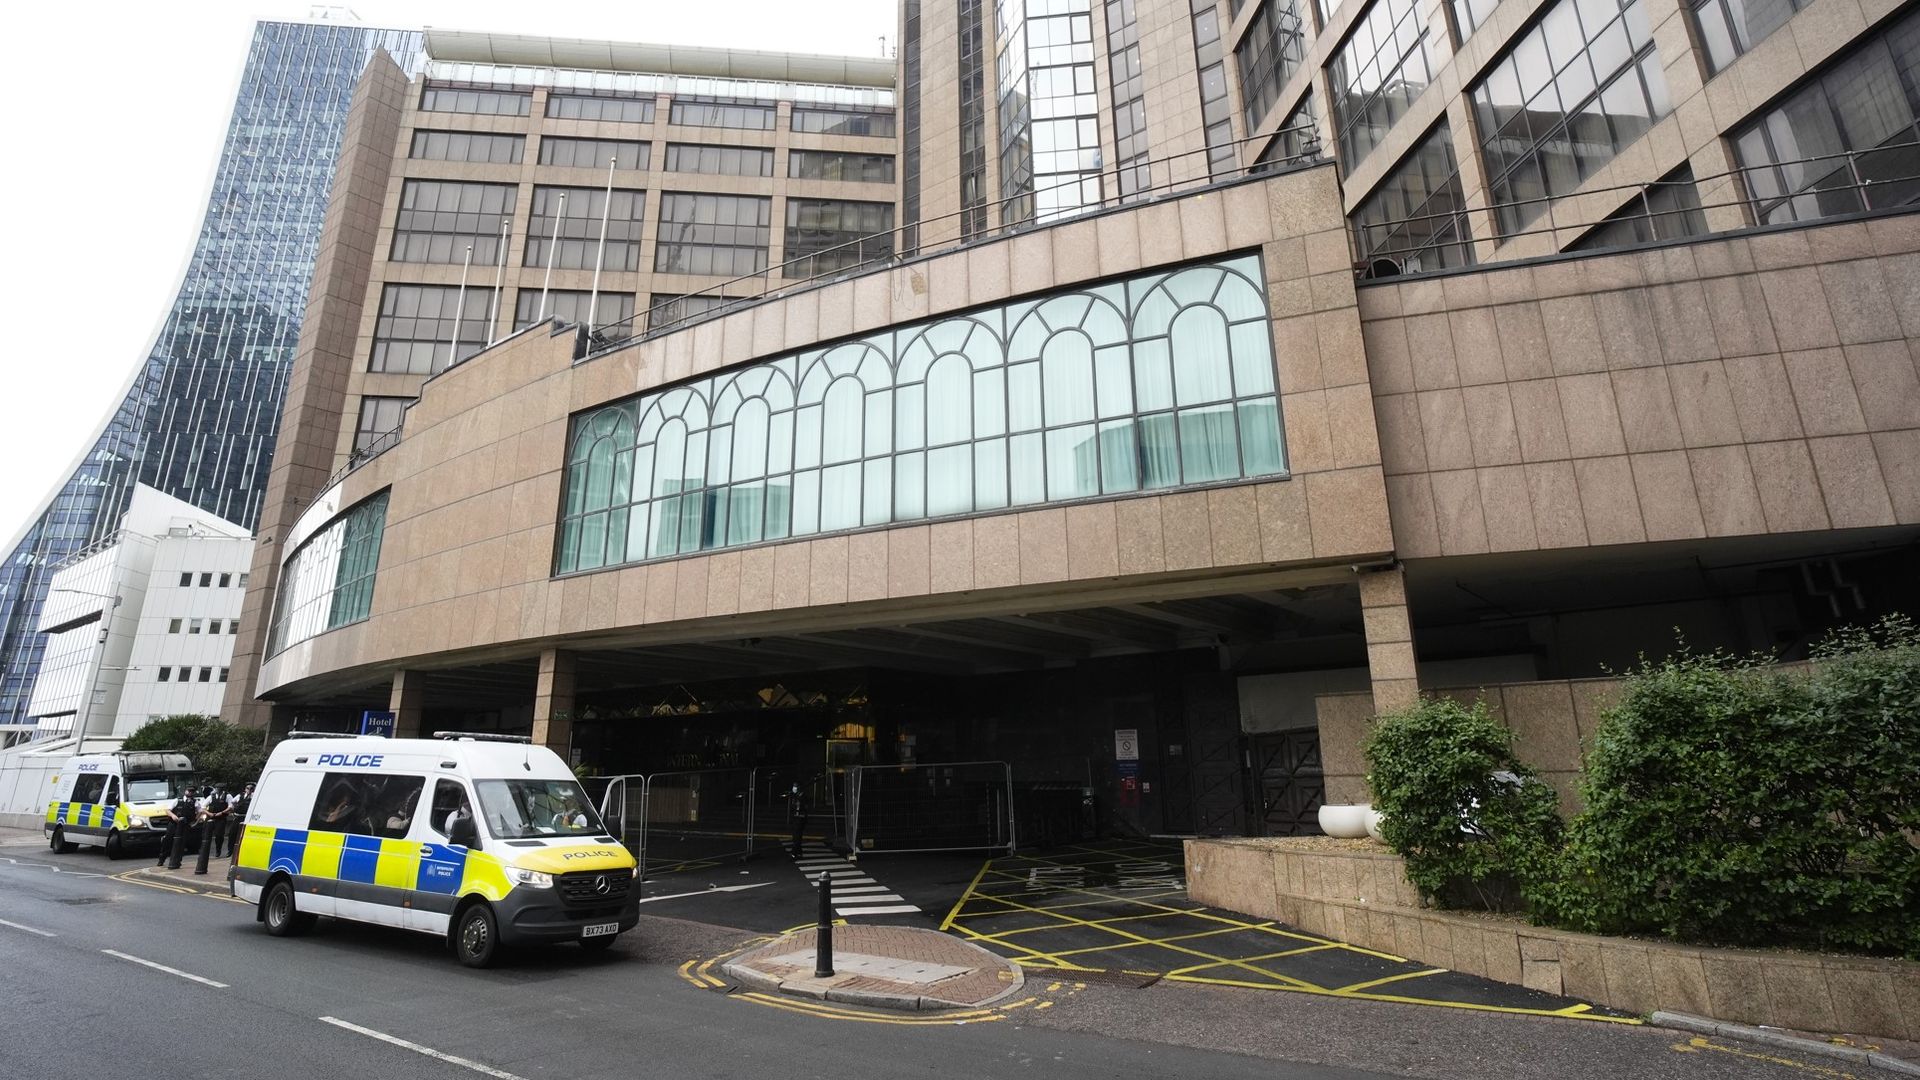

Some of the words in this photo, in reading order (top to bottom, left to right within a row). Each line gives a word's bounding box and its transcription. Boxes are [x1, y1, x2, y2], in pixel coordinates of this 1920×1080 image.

[368, 717, 392, 726] Hotel
[317, 754, 385, 767] POLICE
[78, 763, 99, 771] POLICE
[563, 850, 618, 860] POLICE
[585, 926, 604, 936] BX73
